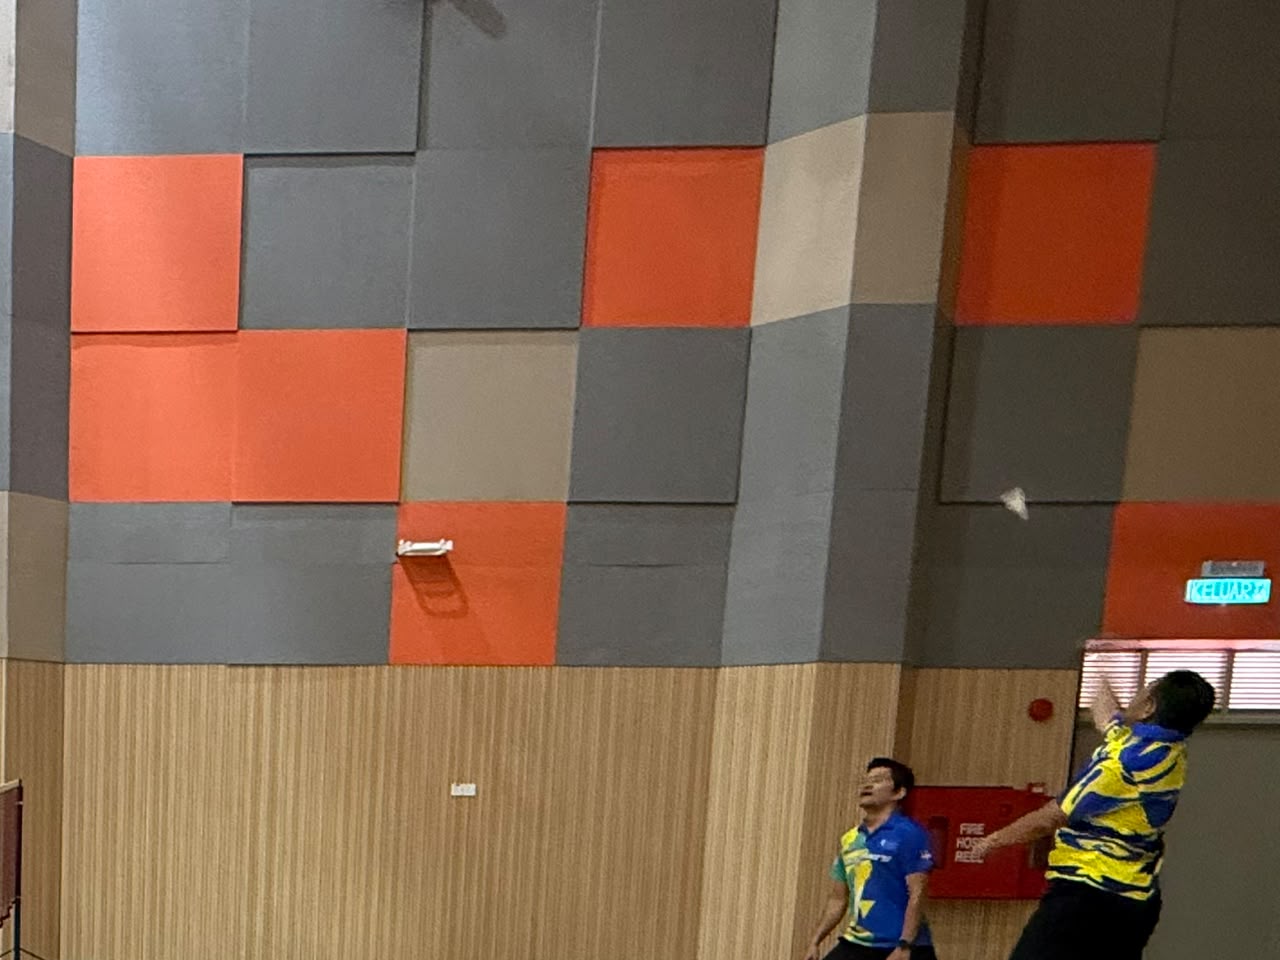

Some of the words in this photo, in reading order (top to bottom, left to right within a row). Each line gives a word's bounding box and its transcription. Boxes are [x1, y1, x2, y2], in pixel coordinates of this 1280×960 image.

[1192, 581, 1254, 600] KELUAR
[959, 823, 985, 835] FIRE
[956, 837, 987, 850] HOS
